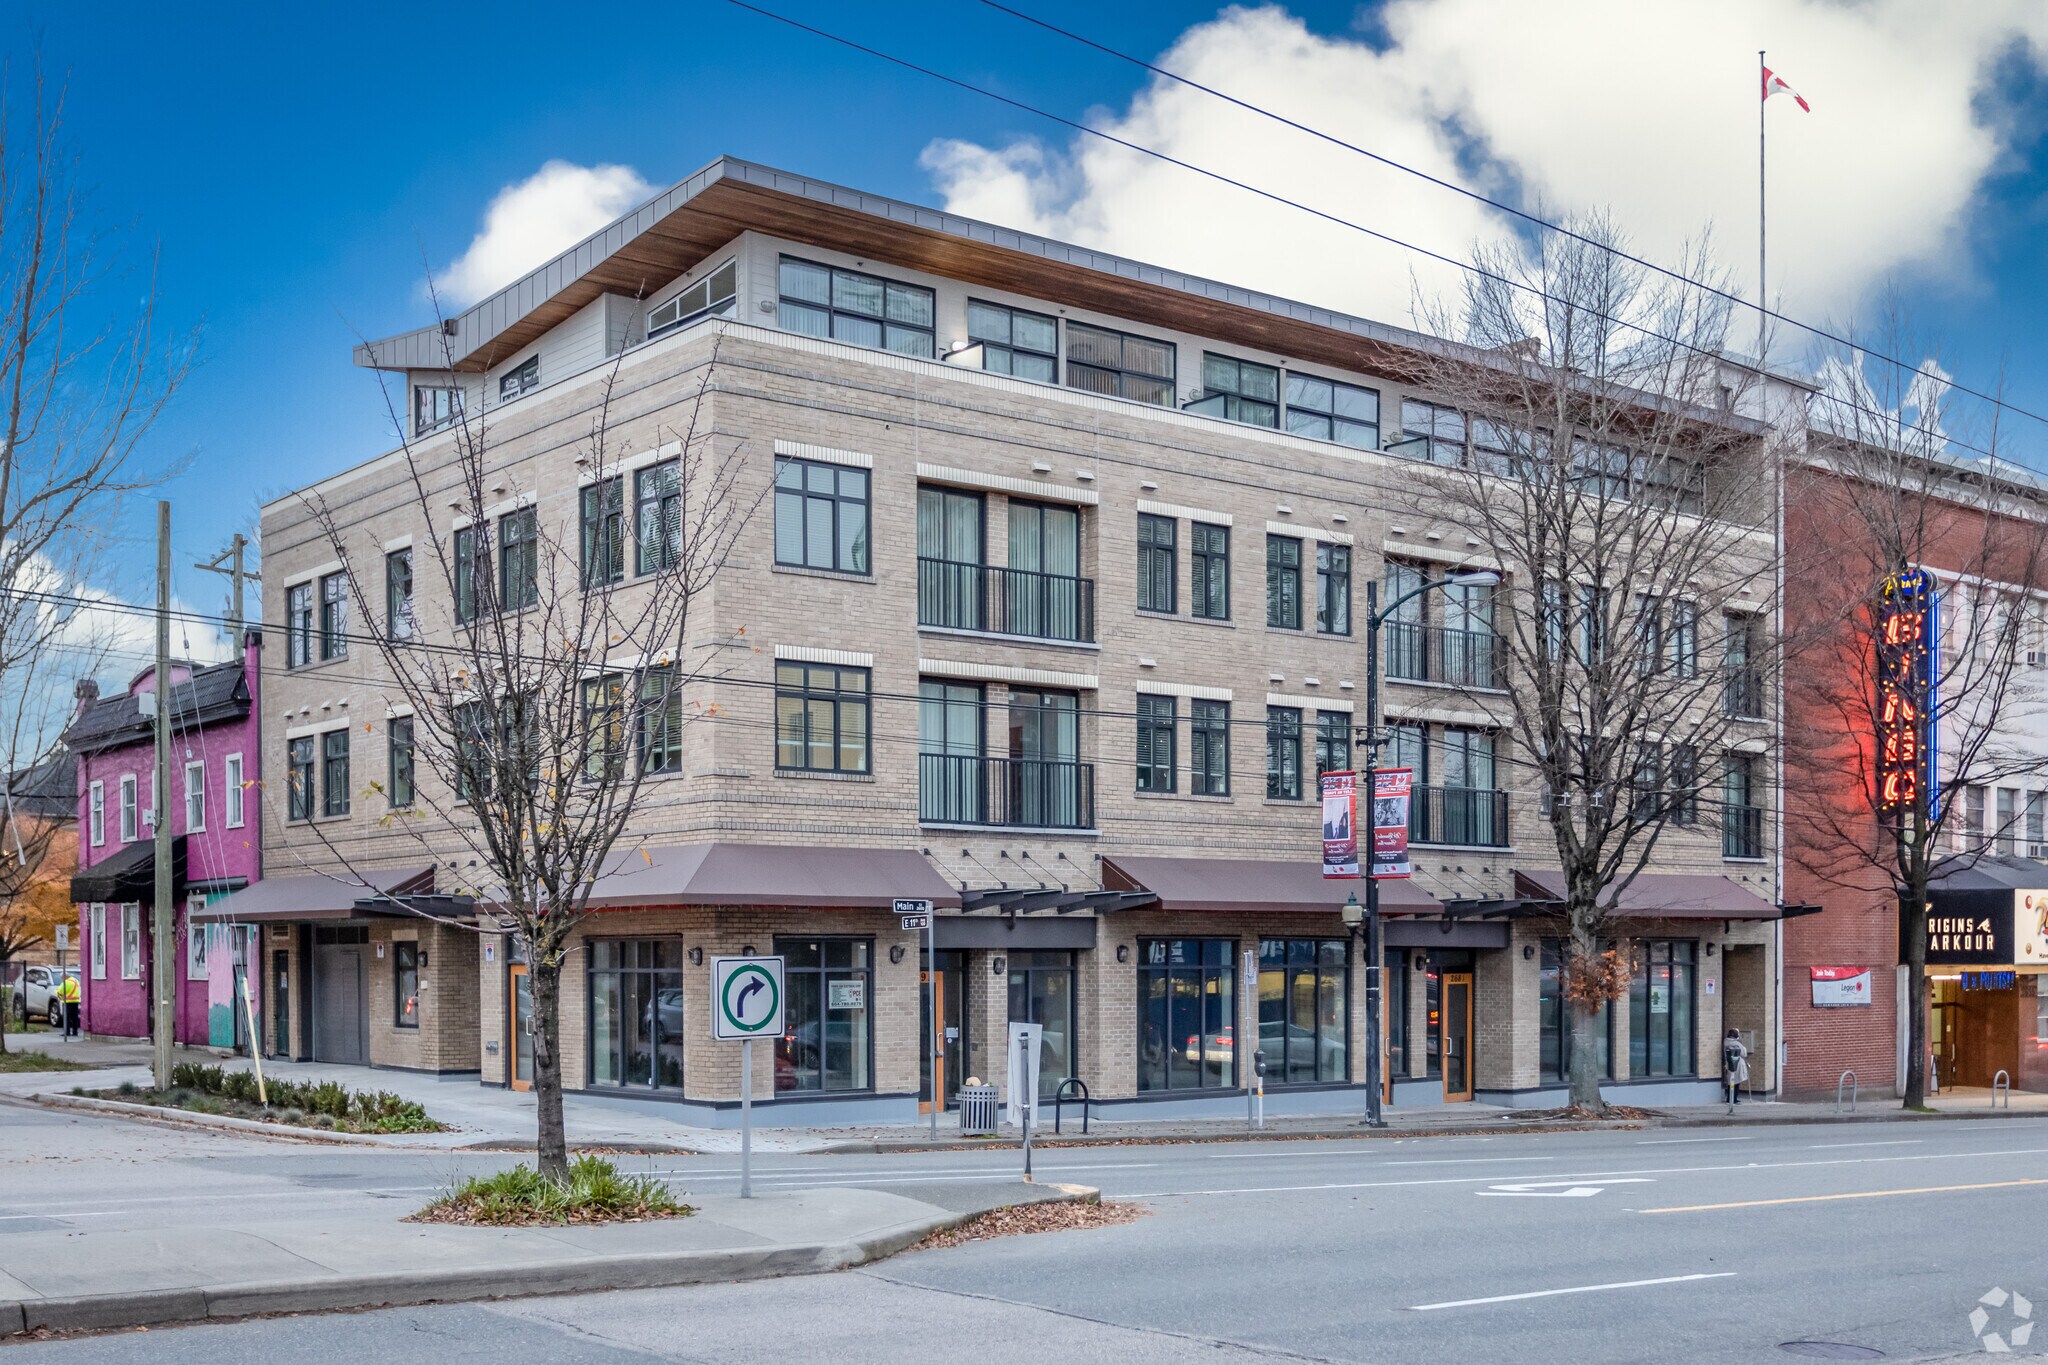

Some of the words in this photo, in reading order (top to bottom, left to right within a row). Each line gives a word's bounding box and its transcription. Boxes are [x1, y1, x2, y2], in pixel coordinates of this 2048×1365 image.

[896, 902, 914, 910] Main
[904, 919, 909, 927] E
[1928, 918, 1973, 933] RIGINS
[1930, 935, 1994, 951] ARKOUR
[1841, 984, 1856, 993] Legion
